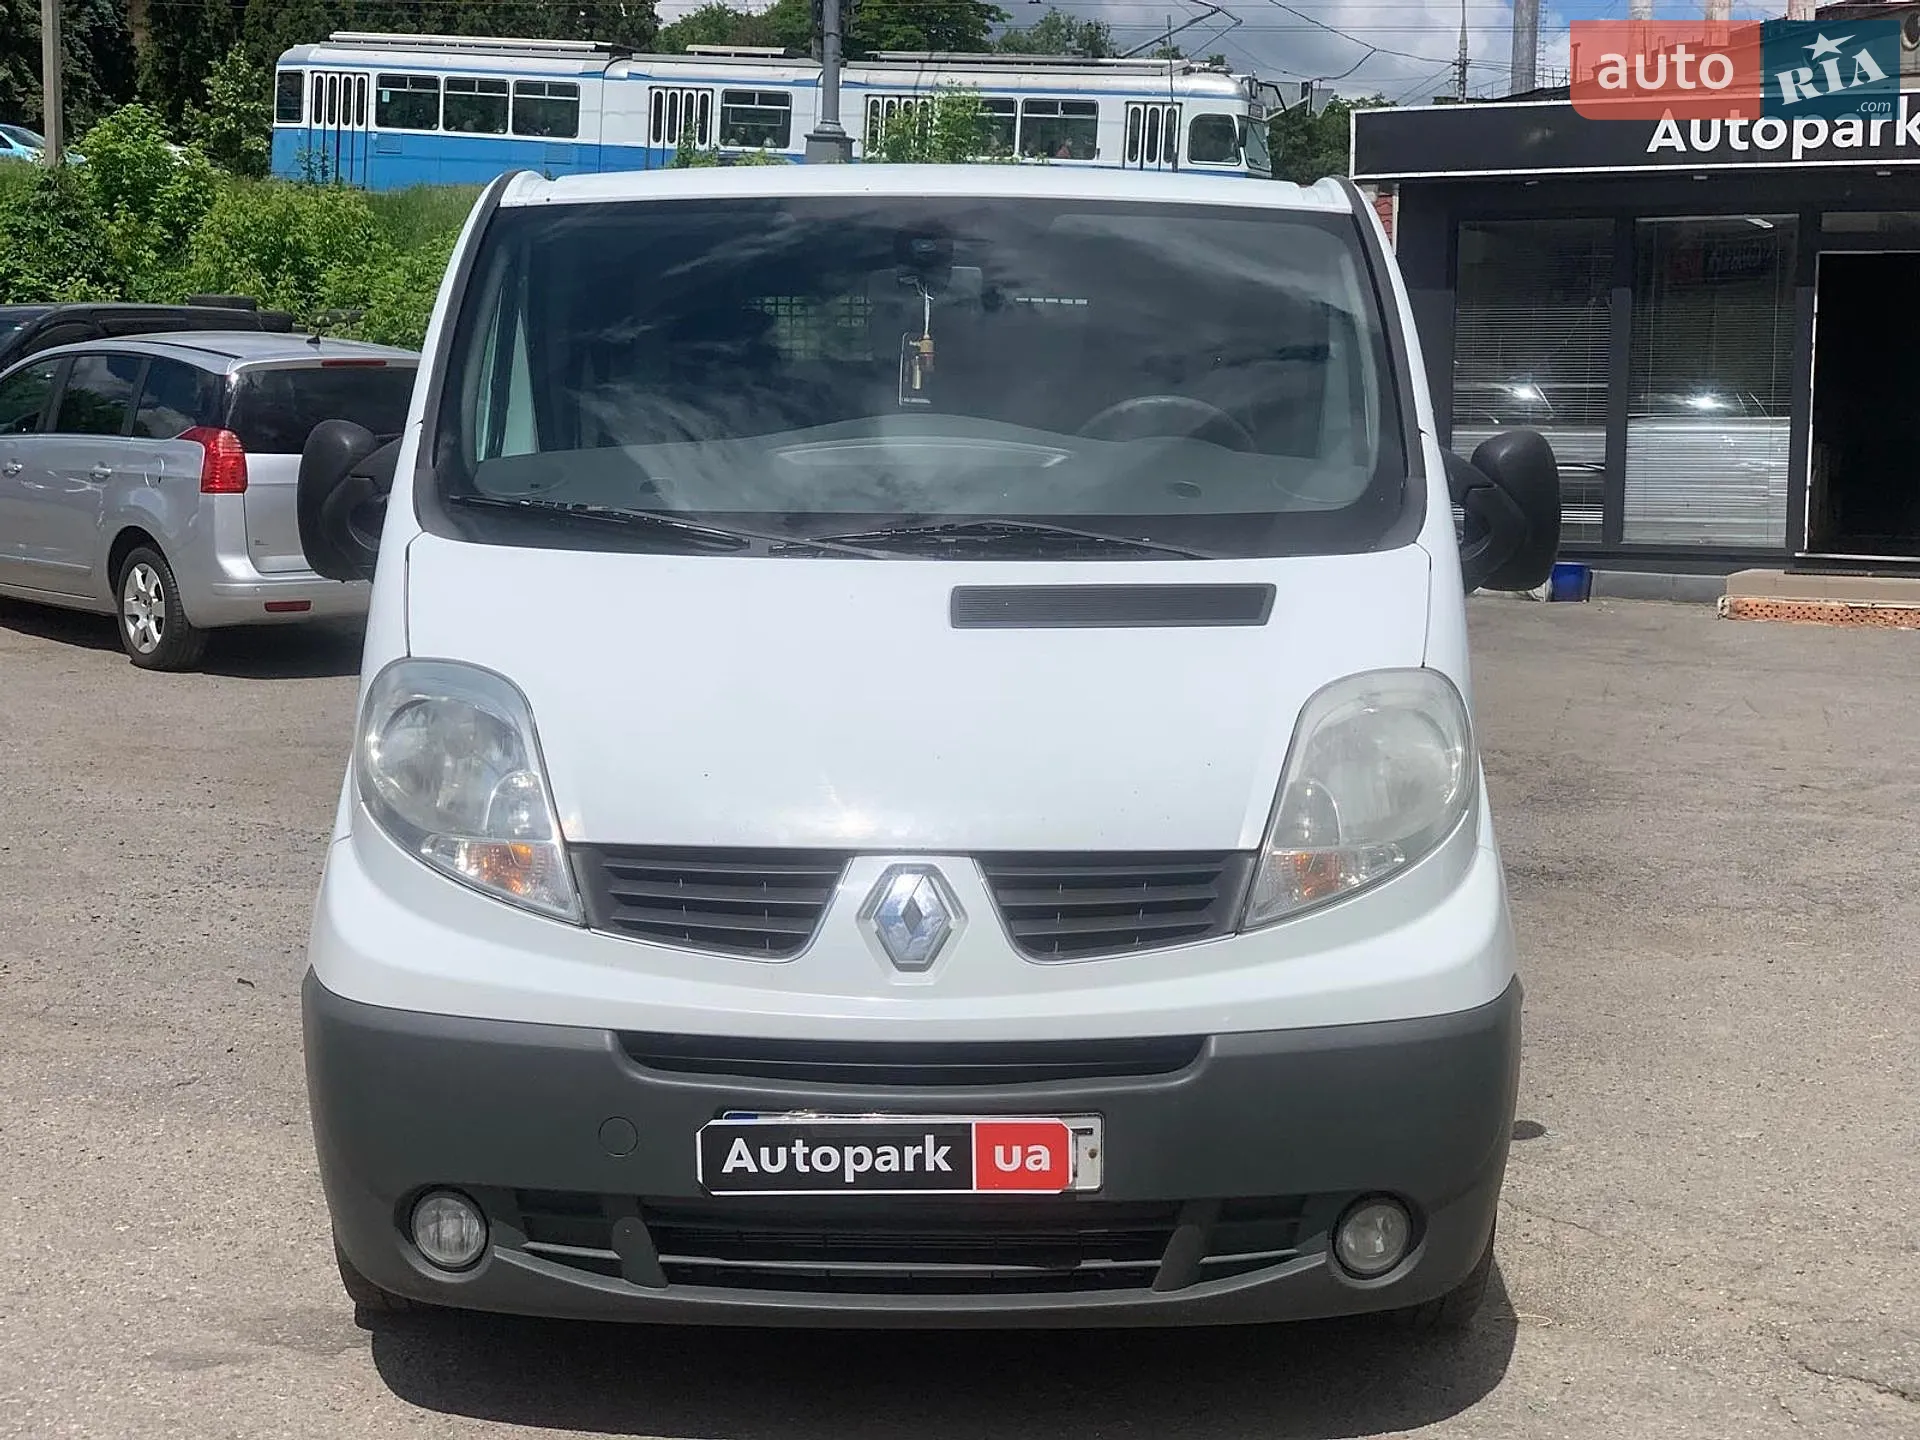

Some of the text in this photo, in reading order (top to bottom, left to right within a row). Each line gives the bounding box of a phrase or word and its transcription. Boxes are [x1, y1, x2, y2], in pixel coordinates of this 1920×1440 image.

[1646, 96, 1920, 160] Autopark
[721, 1135, 952, 1182] Autopark
[994, 1146, 1051, 1171] ua
